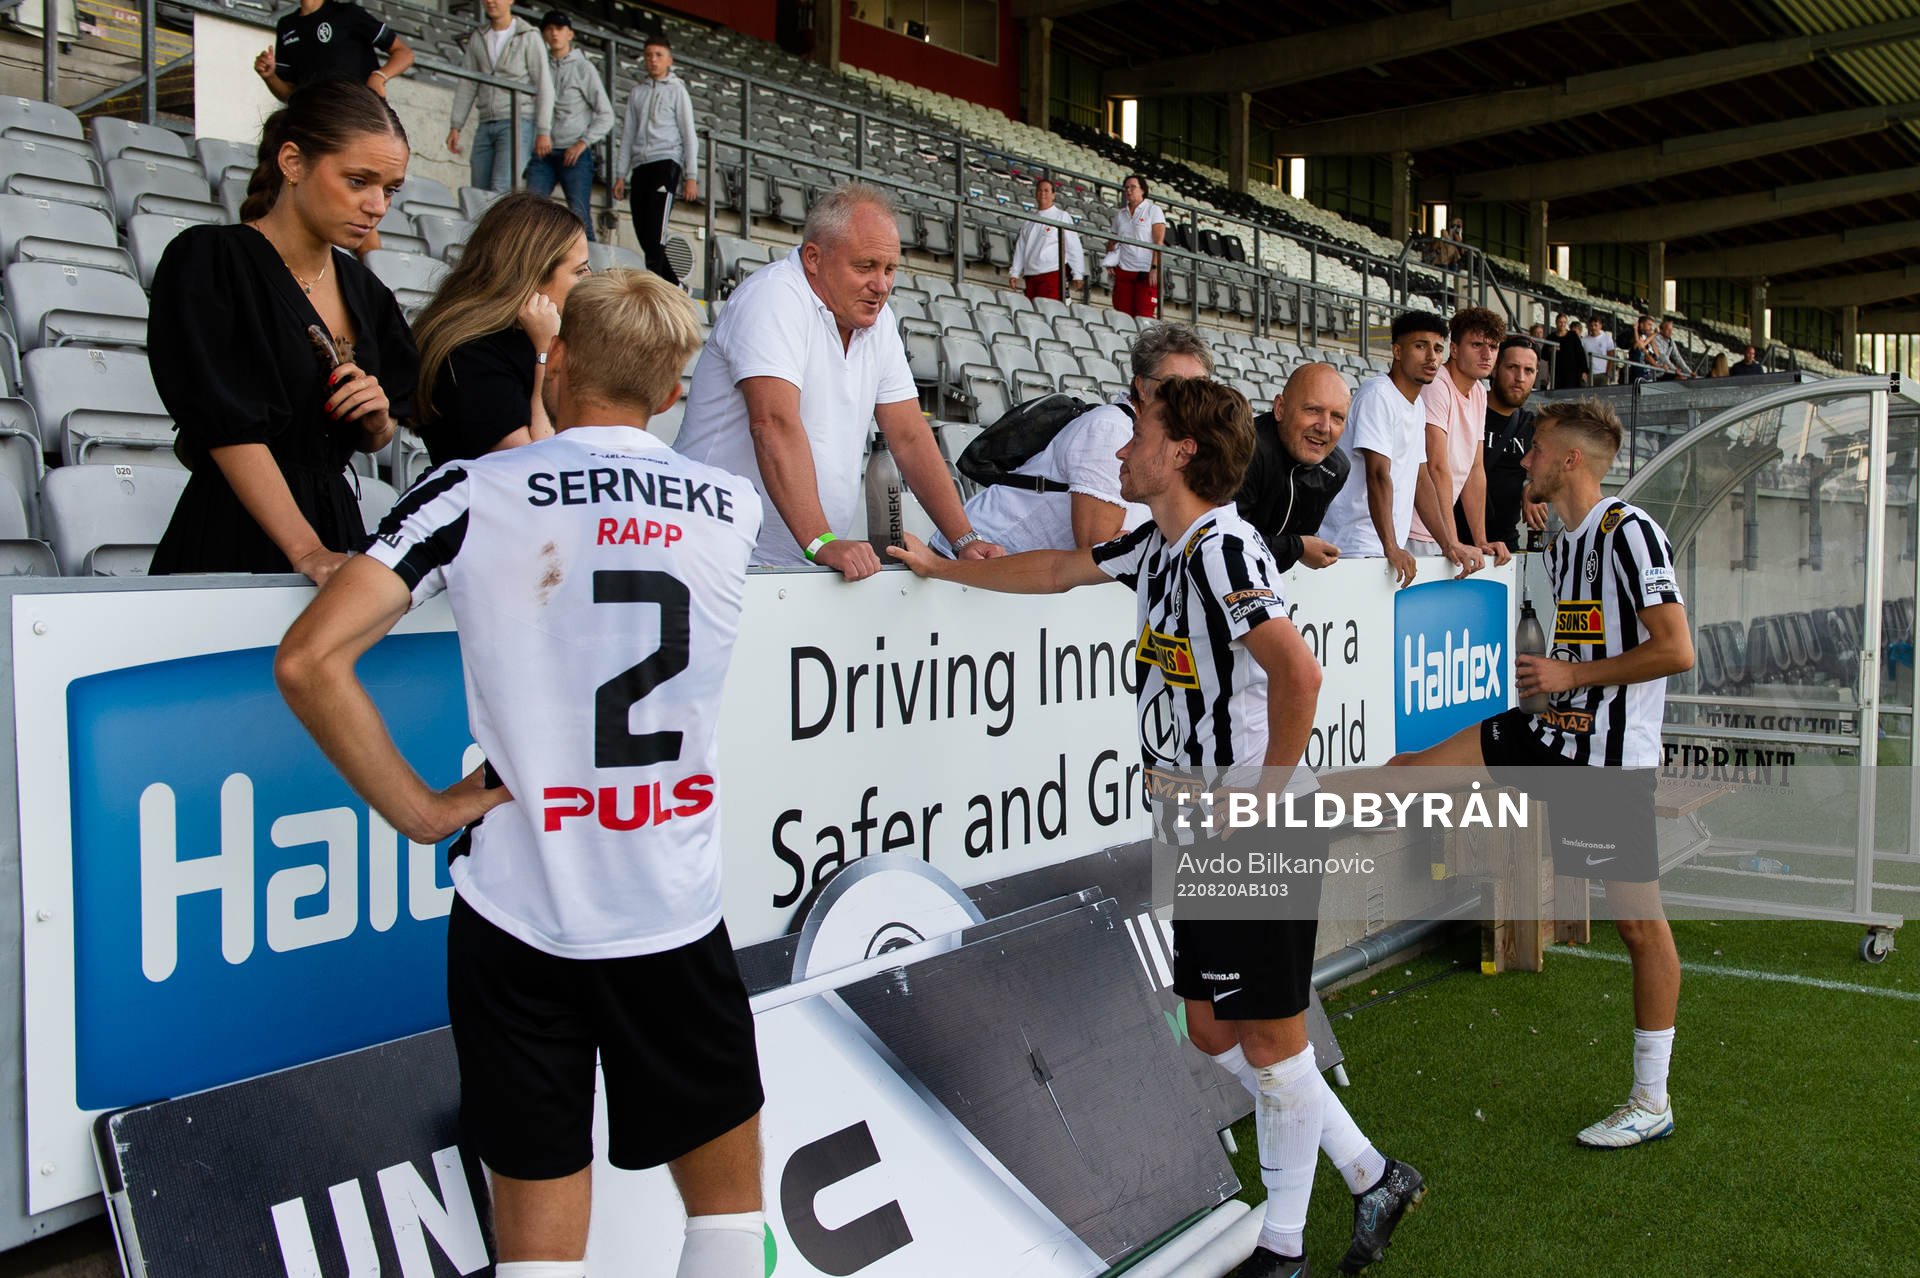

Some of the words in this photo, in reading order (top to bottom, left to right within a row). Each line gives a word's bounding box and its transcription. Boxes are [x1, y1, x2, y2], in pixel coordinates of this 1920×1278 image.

[116, 467, 131, 475] 020
[527, 467, 734, 524] SERNEKE
[596, 517, 682, 548] RAPP
[592, 569, 691, 769] 2
[791, 632, 1015, 738] Driving
[1343, 618, 1359, 666] a
[1404, 627, 1501, 717] Haldex
[1661, 742, 1795, 787] EJBRANT
[543, 773, 715, 833] PULS
[771, 785, 943, 908] Safer
[964, 753, 1067, 859] and
